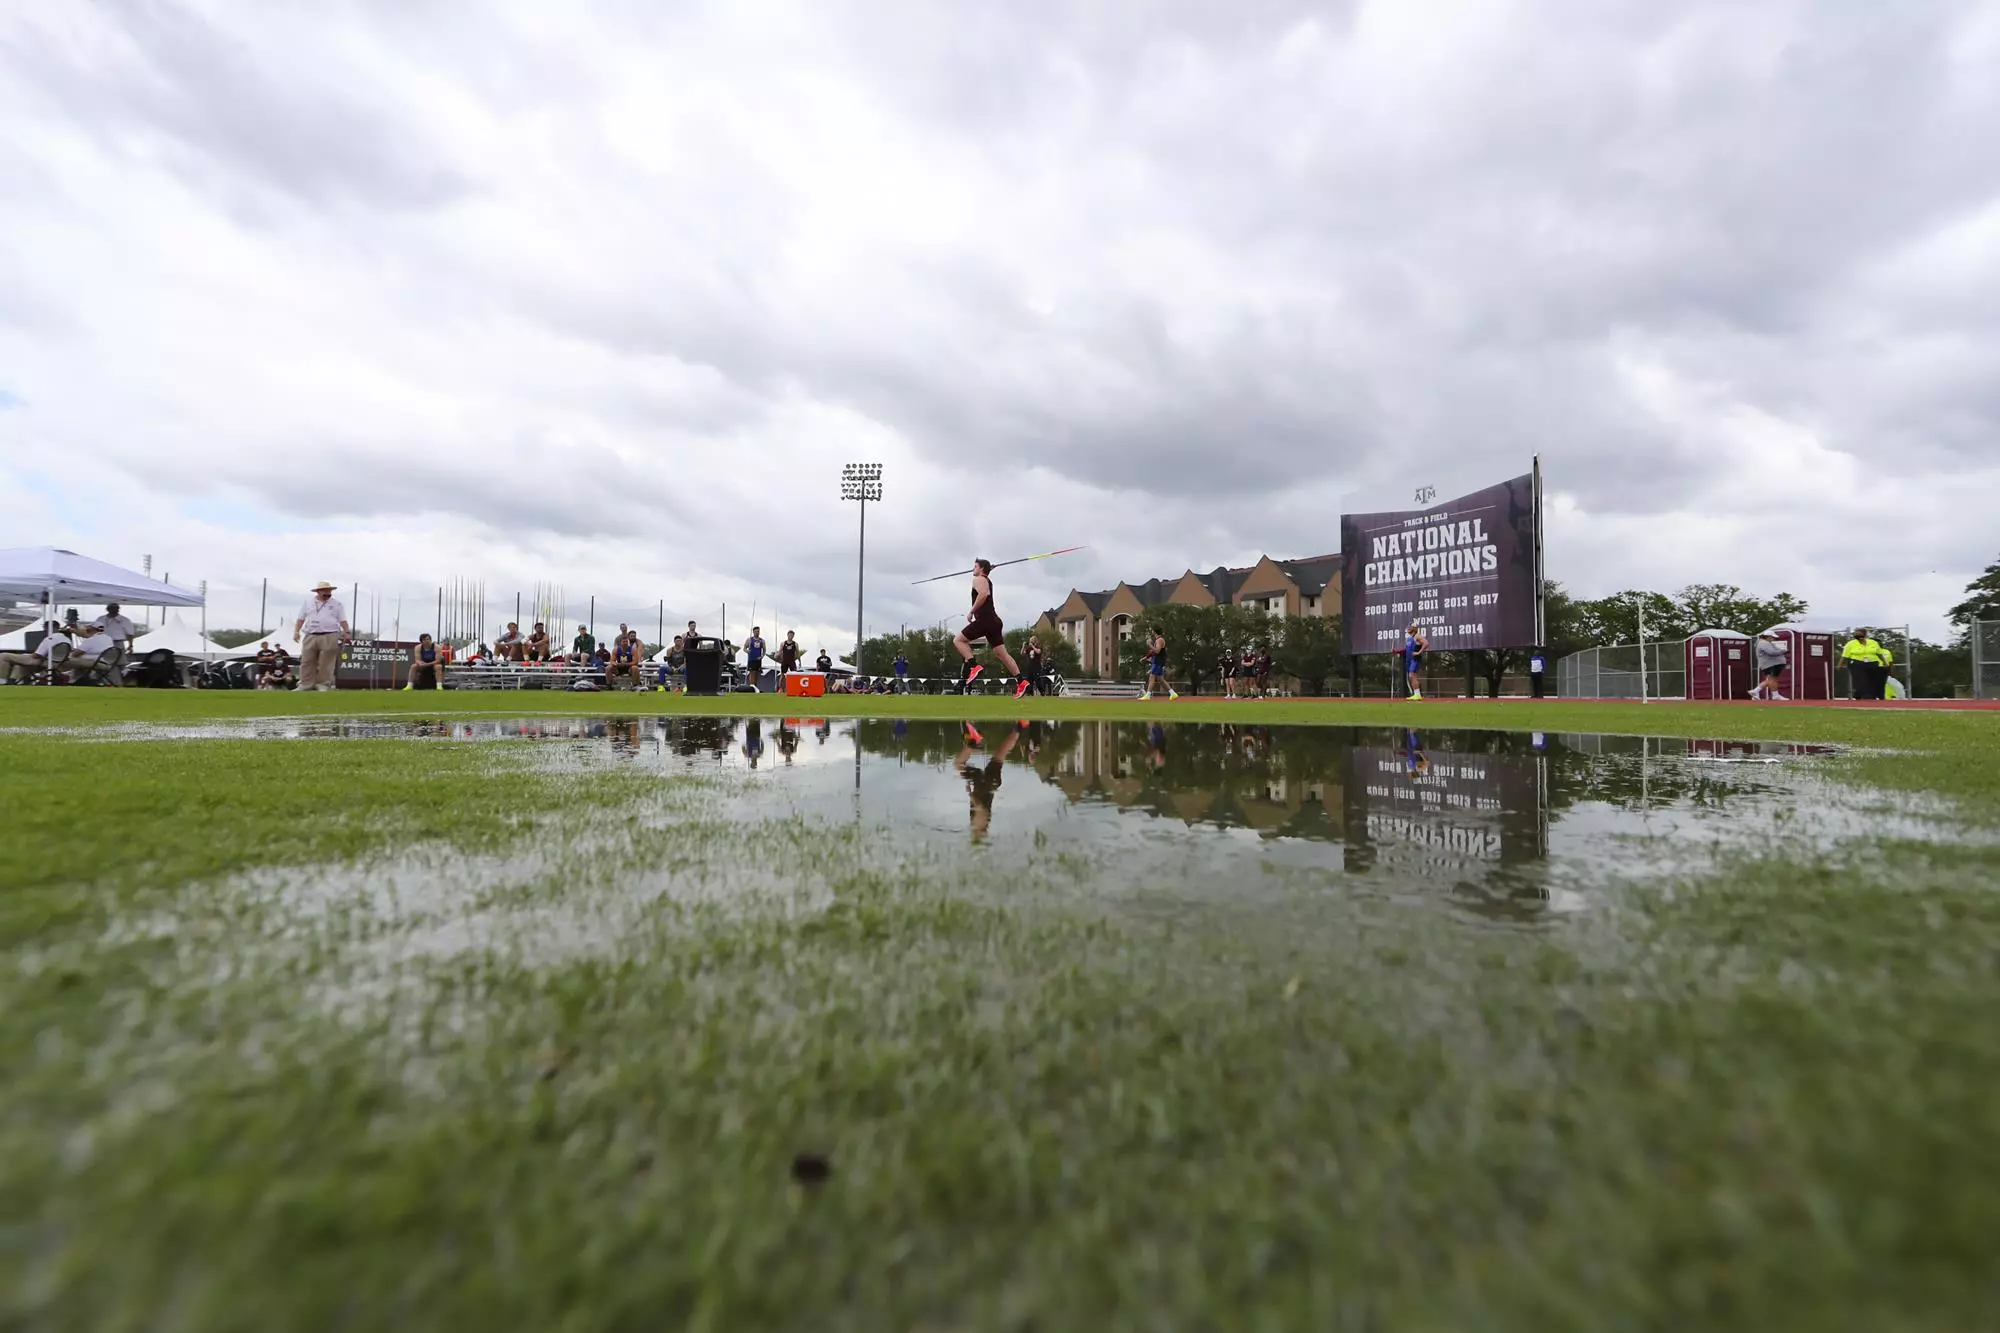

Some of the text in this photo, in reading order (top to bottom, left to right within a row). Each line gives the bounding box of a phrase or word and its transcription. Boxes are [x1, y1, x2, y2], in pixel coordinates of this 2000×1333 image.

[1403, 518, 1423, 527] TRACK
[1430, 512, 1448, 522] FIELD
[1373, 518, 1488, 559] NATIONAL
[1365, 544, 1498, 586] CHAMPIONS
[1420, 589, 1438, 598] MEN
[1365, 593, 1499, 616] 2009 2010 2011 2013 2017
[1413, 616, 1445, 625] WOMEN
[1377, 629, 1400, 640] 2009
[1432, 626, 1453, 636] 2011
[1459, 624, 1483, 634] 2014
[800, 677, 810, 687] G
